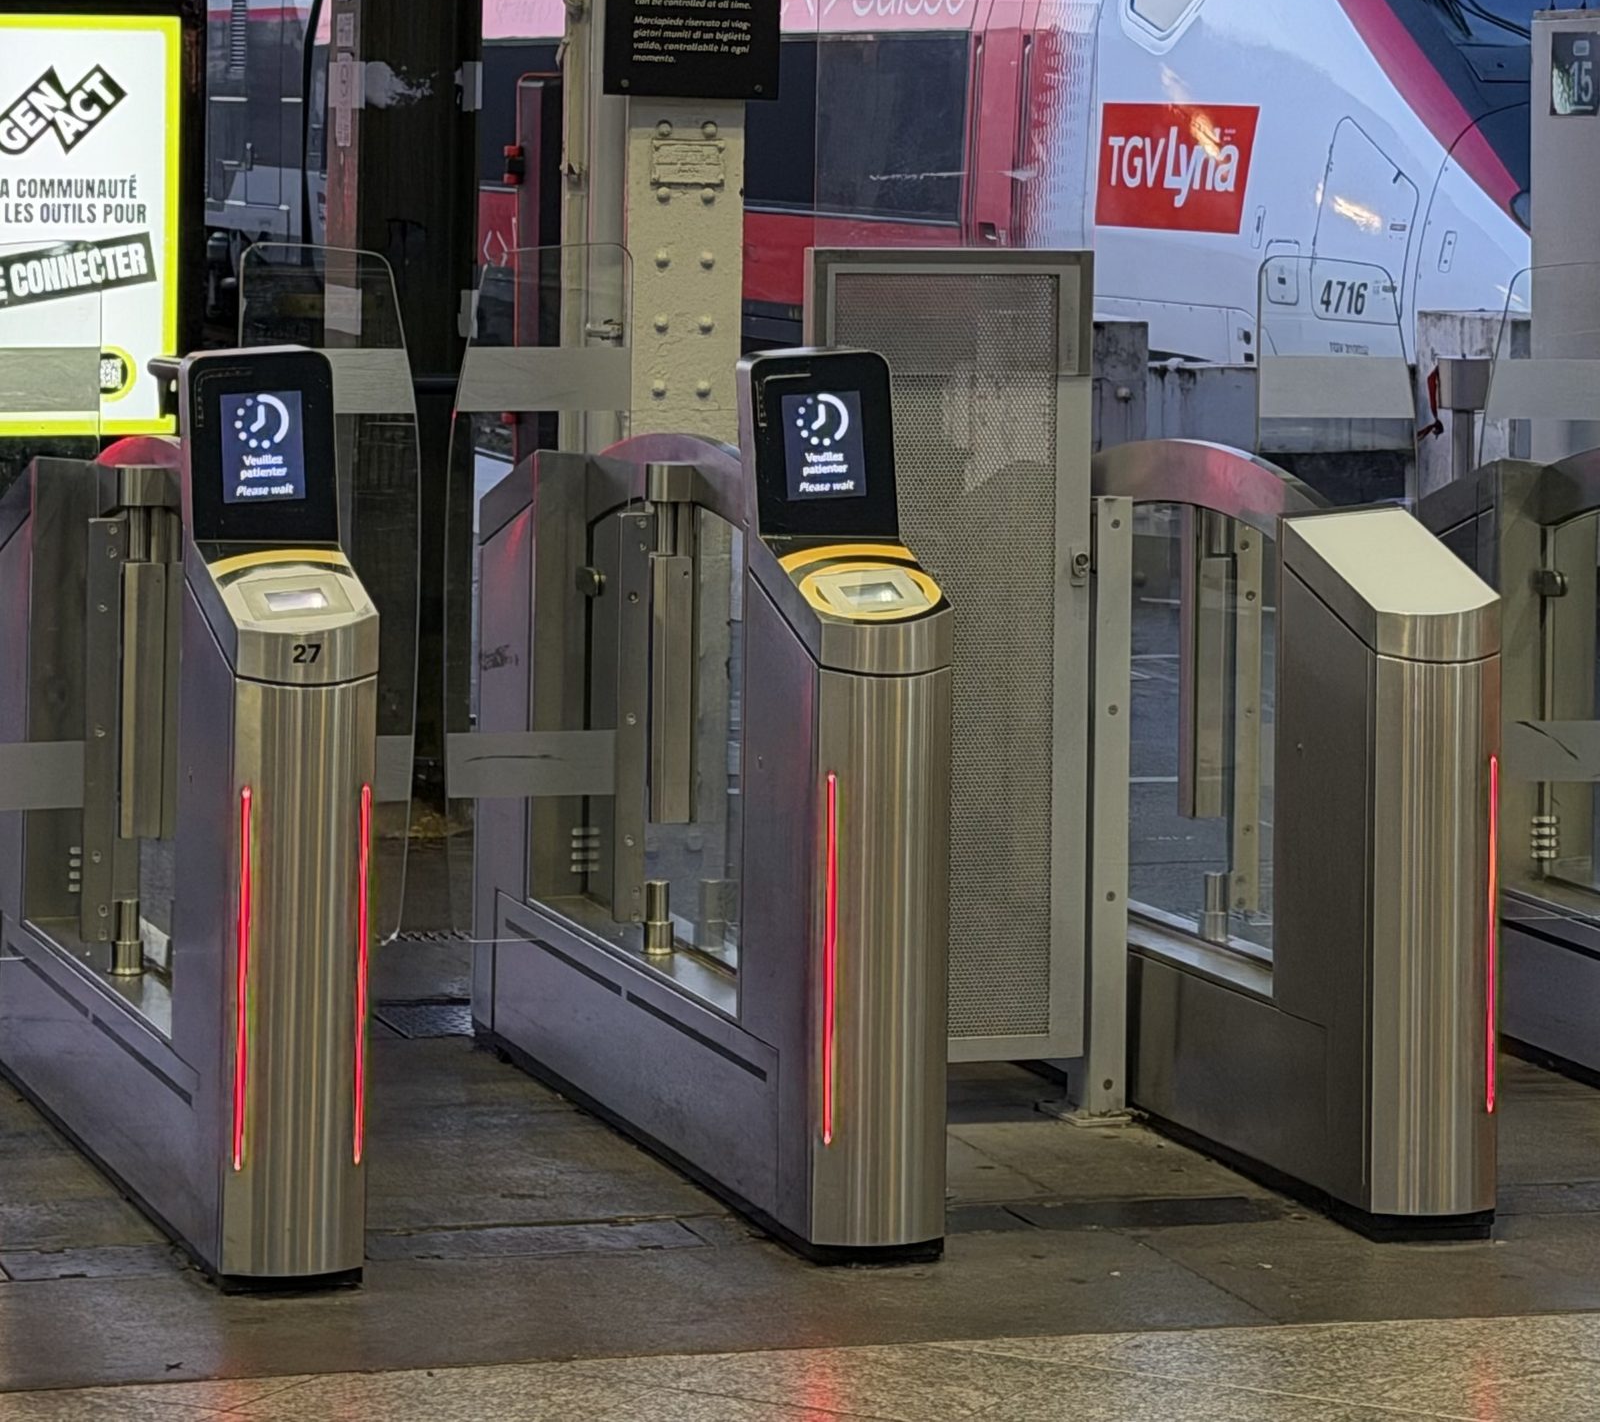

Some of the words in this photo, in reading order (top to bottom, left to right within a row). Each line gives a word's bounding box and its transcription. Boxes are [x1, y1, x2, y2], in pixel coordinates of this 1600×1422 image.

[706, 0, 717, 8] at
[1570, 61, 1593, 103] 15
[0, 80, 67, 151] GEN
[53, 71, 115, 145] ACT
[17, 175, 137, 199] COMMUNAUTÉ
[5, 203, 34, 223] LES
[40, 203, 97, 223] OUTILS
[103, 203, 147, 223] POUR
[10, 242, 148, 297] CONNECTER
[1320, 279, 1368, 315] 4716
[242, 454, 283, 466] Veuillez
[805, 452, 844, 463] Veuillez
[240, 465, 288, 480] patienter
[802, 463, 848, 477] patienter
[236, 484, 268, 497] Please
[270, 483, 294, 495] wait
[799, 481, 830, 493] Please
[832, 479, 854, 490] wait
[293, 644, 321, 663] 27
